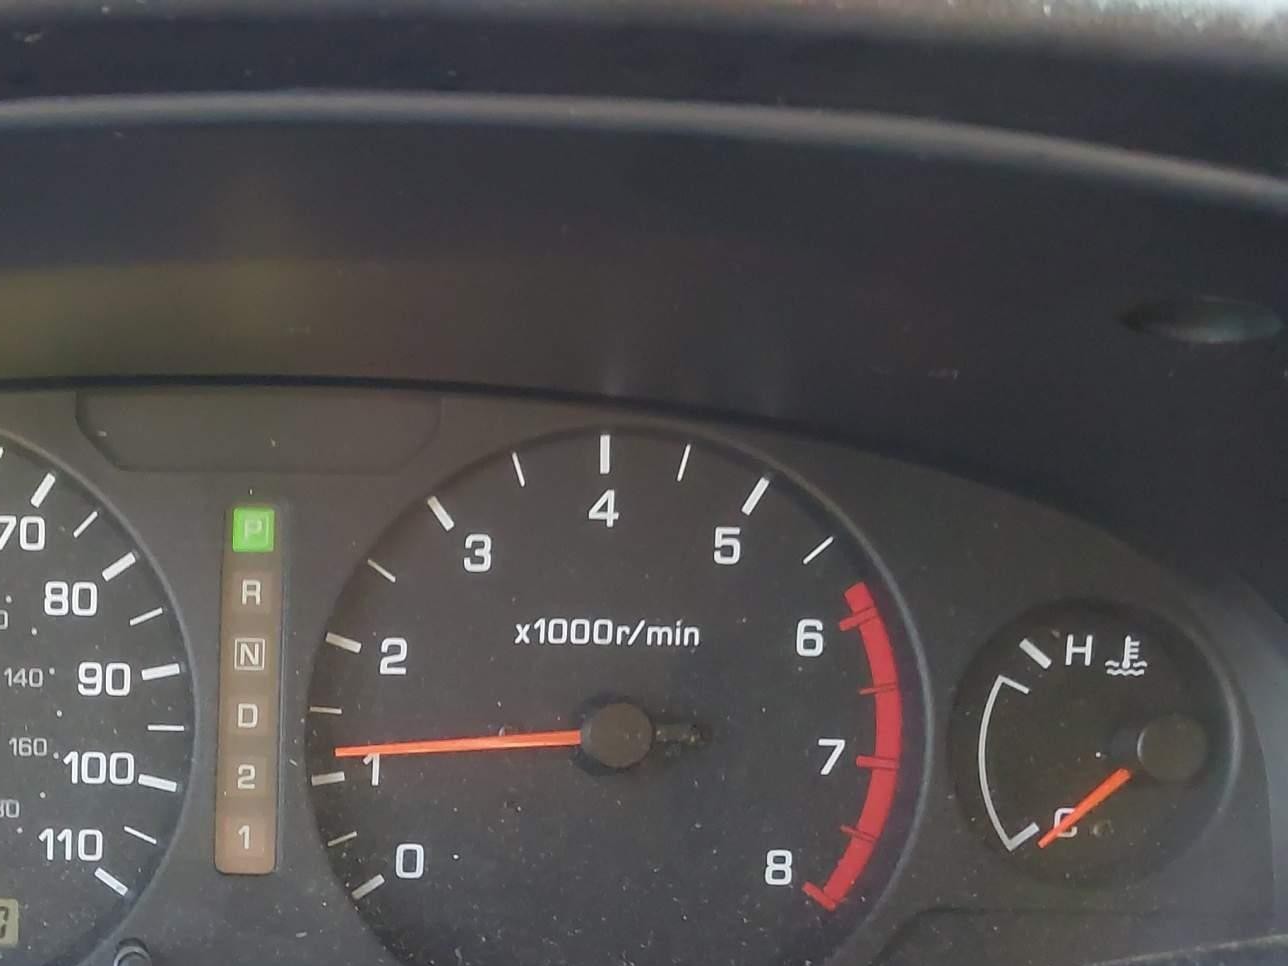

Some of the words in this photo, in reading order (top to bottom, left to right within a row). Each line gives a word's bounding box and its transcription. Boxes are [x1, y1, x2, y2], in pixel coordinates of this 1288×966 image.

[588, 489, 619, 527] 4
[243, 518, 262, 539] P
[713, 526, 741, 564] 5
[463, 534, 492, 572] 3
[44, 581, 98, 616] 80
[242, 580, 261, 605] R
[514, 618, 701, 647] x1000r/min
[796, 620, 824, 656] 6
[239, 643, 260, 668] N
[379, 637, 407, 675] 2
[1065, 634, 1093, 666] H
[4, 667, 44, 688] 140
[77, 661, 131, 696] 90
[237, 703, 259, 729] D
[9, 737, 48, 757] 160
[818, 738, 845, 774] 7
[63, 751, 135, 785] 100
[238, 764, 256, 790] 2
[363, 752, 380, 786] 1
[238, 825, 251, 849] 1
[1054, 807, 1078, 838] C
[38, 828, 104, 862] 110
[396, 844, 424, 878] 0
[765, 850, 792, 886] 8
